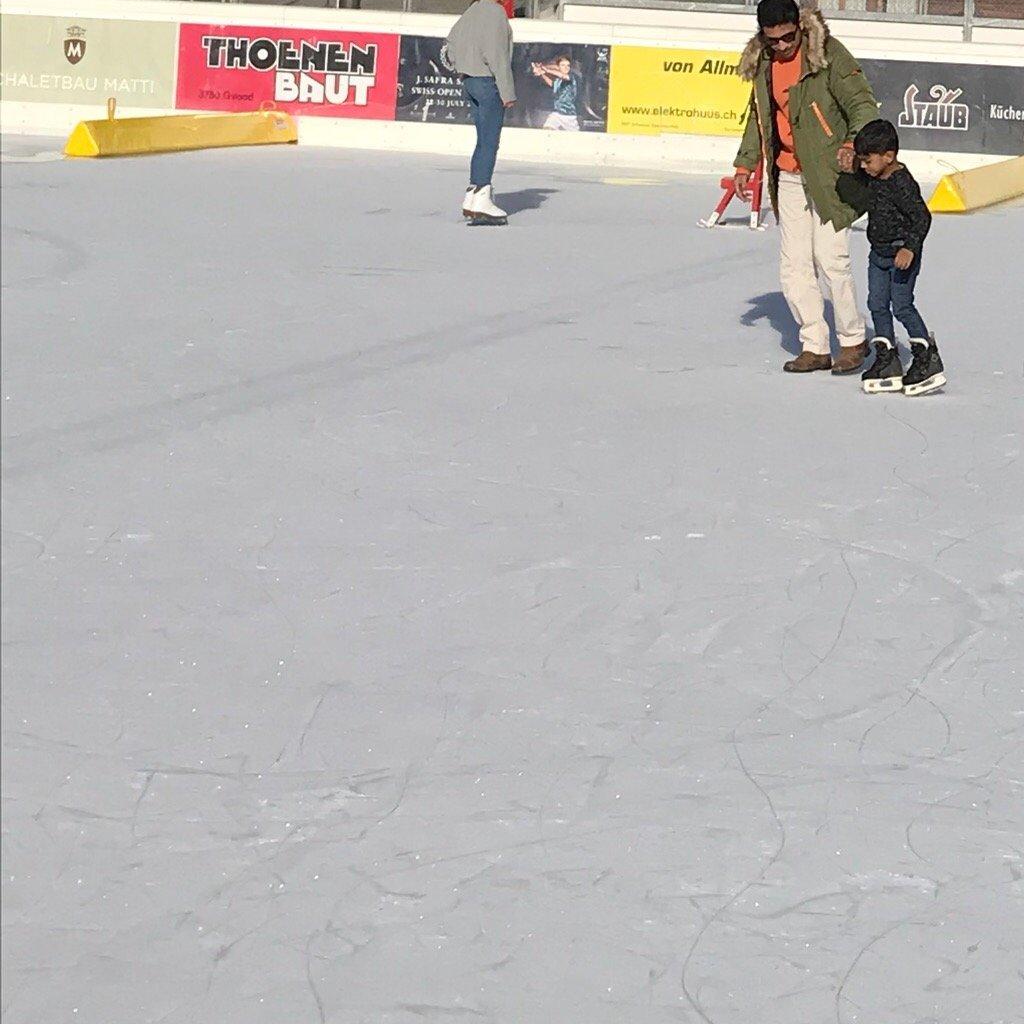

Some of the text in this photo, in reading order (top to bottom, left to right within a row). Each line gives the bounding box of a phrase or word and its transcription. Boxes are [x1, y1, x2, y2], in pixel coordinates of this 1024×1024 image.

[202, 36, 377, 75] THOENEN
[664, 59, 741, 76] von Allm
[104, 78, 154, 93] MATTI
[275, 71, 375, 106] BAUT
[424, 76, 453, 85] SAFRA
[411, 87, 462, 96] SWISS OPEN
[621, 105, 737, 120] www.elektrohuus.ch
[899, 84, 969, 131] STAUB
